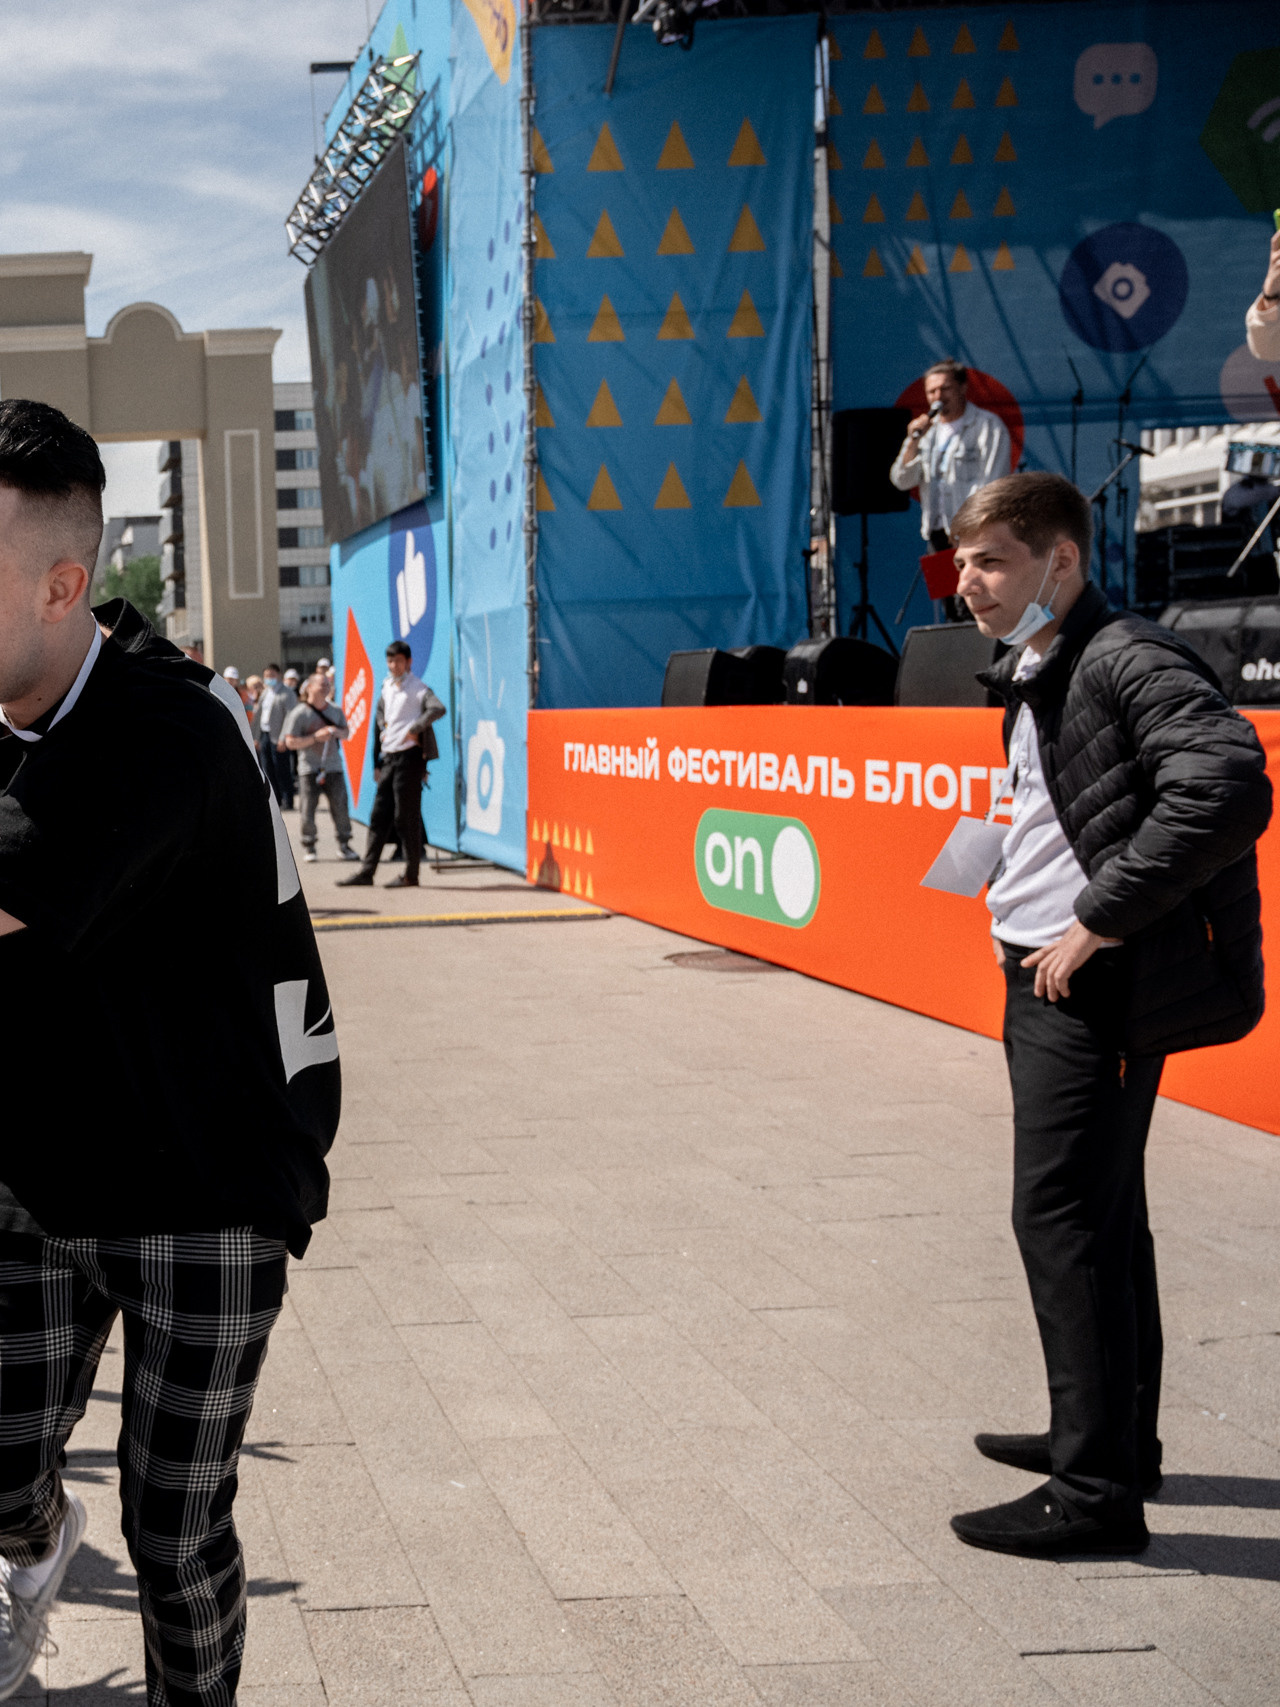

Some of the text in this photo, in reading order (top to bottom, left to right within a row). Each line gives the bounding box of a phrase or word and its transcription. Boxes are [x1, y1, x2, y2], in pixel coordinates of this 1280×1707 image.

[563, 736, 660, 781] ГЛАВНЫЙ
[667, 745, 856, 800] ФЕСТИВАЛЬ
[704, 831, 765, 895] on
